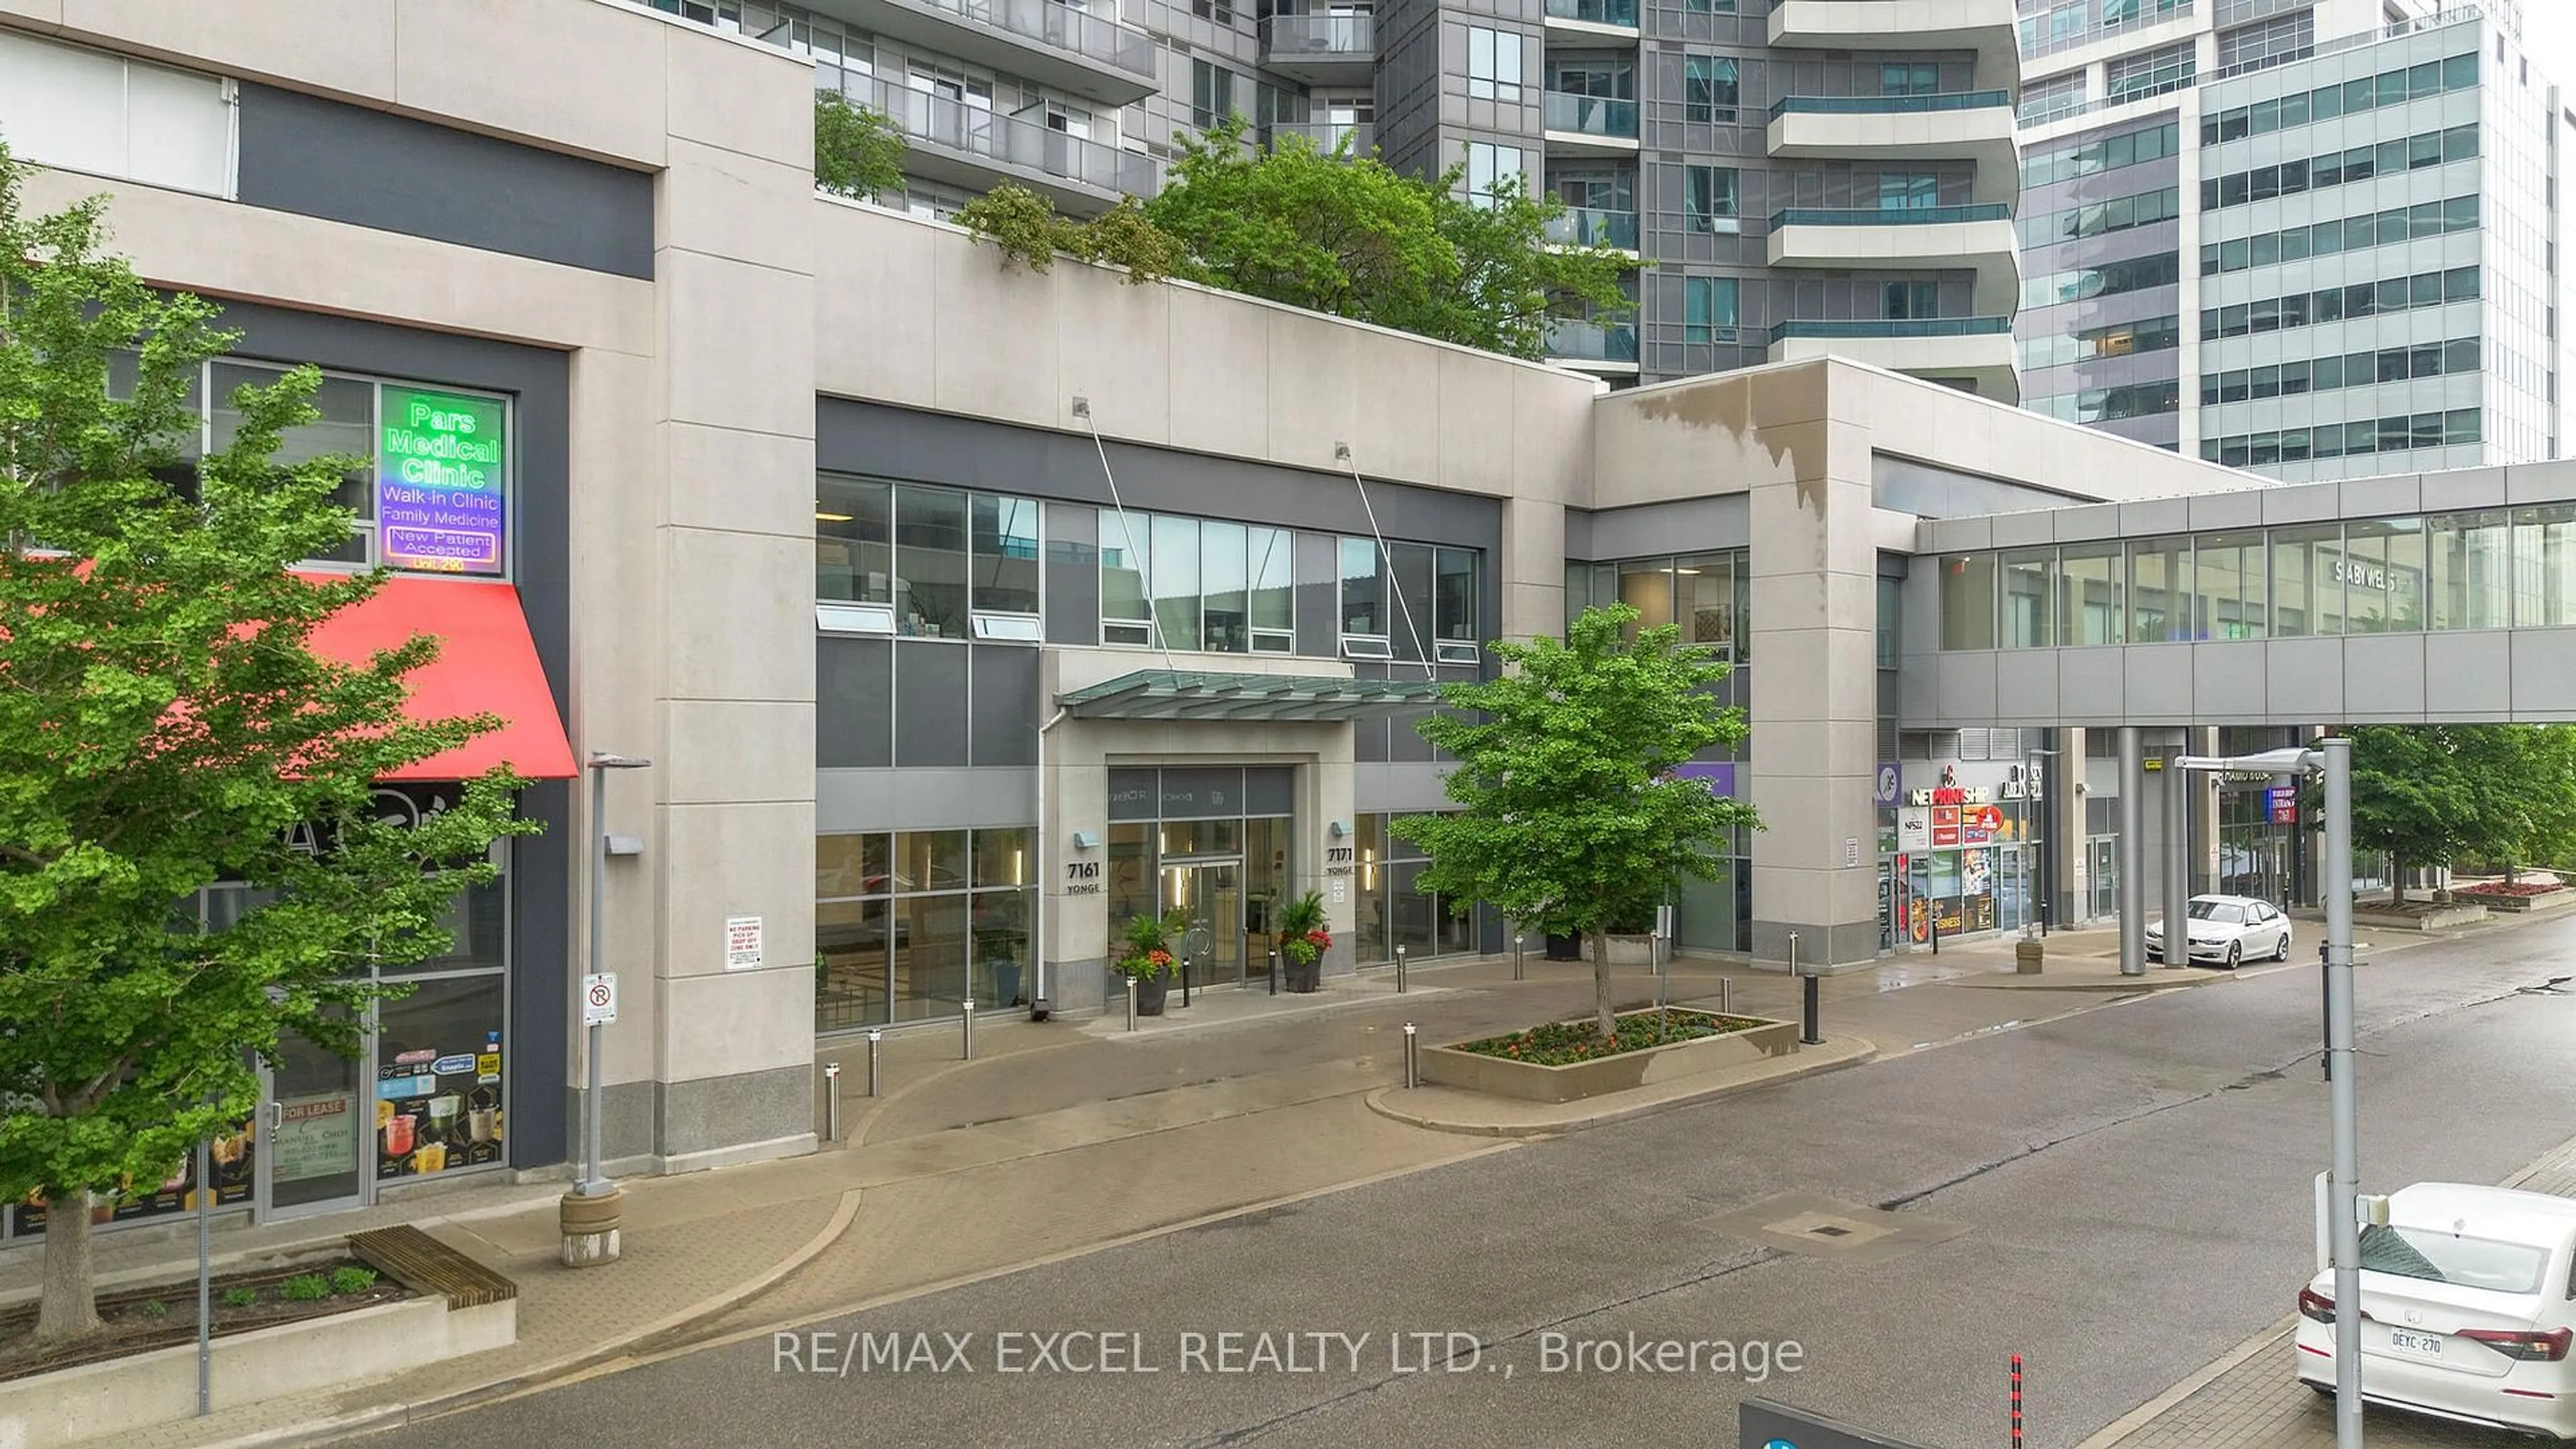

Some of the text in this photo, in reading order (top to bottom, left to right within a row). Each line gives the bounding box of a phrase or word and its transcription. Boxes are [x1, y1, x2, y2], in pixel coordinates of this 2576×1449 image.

[411, 402, 476, 434] Pars
[387, 427, 498, 464] Medical
[402, 457, 486, 489] Clinic
[451, 492, 498, 511] Clinic
[382, 506, 498, 528] Family Medicine
[392, 529, 491, 547] New Patient
[404, 542, 480, 557] Accepted
[2335, 560, 2366, 586] SABY
[1328, 848, 1352, 862] 7171
[1068, 862, 1099, 879] 7161
[1327, 866, 1353, 877] YONGE
[1067, 883, 1100, 895] YONGE
[282, 1102, 341, 1119] FOR LEASE
